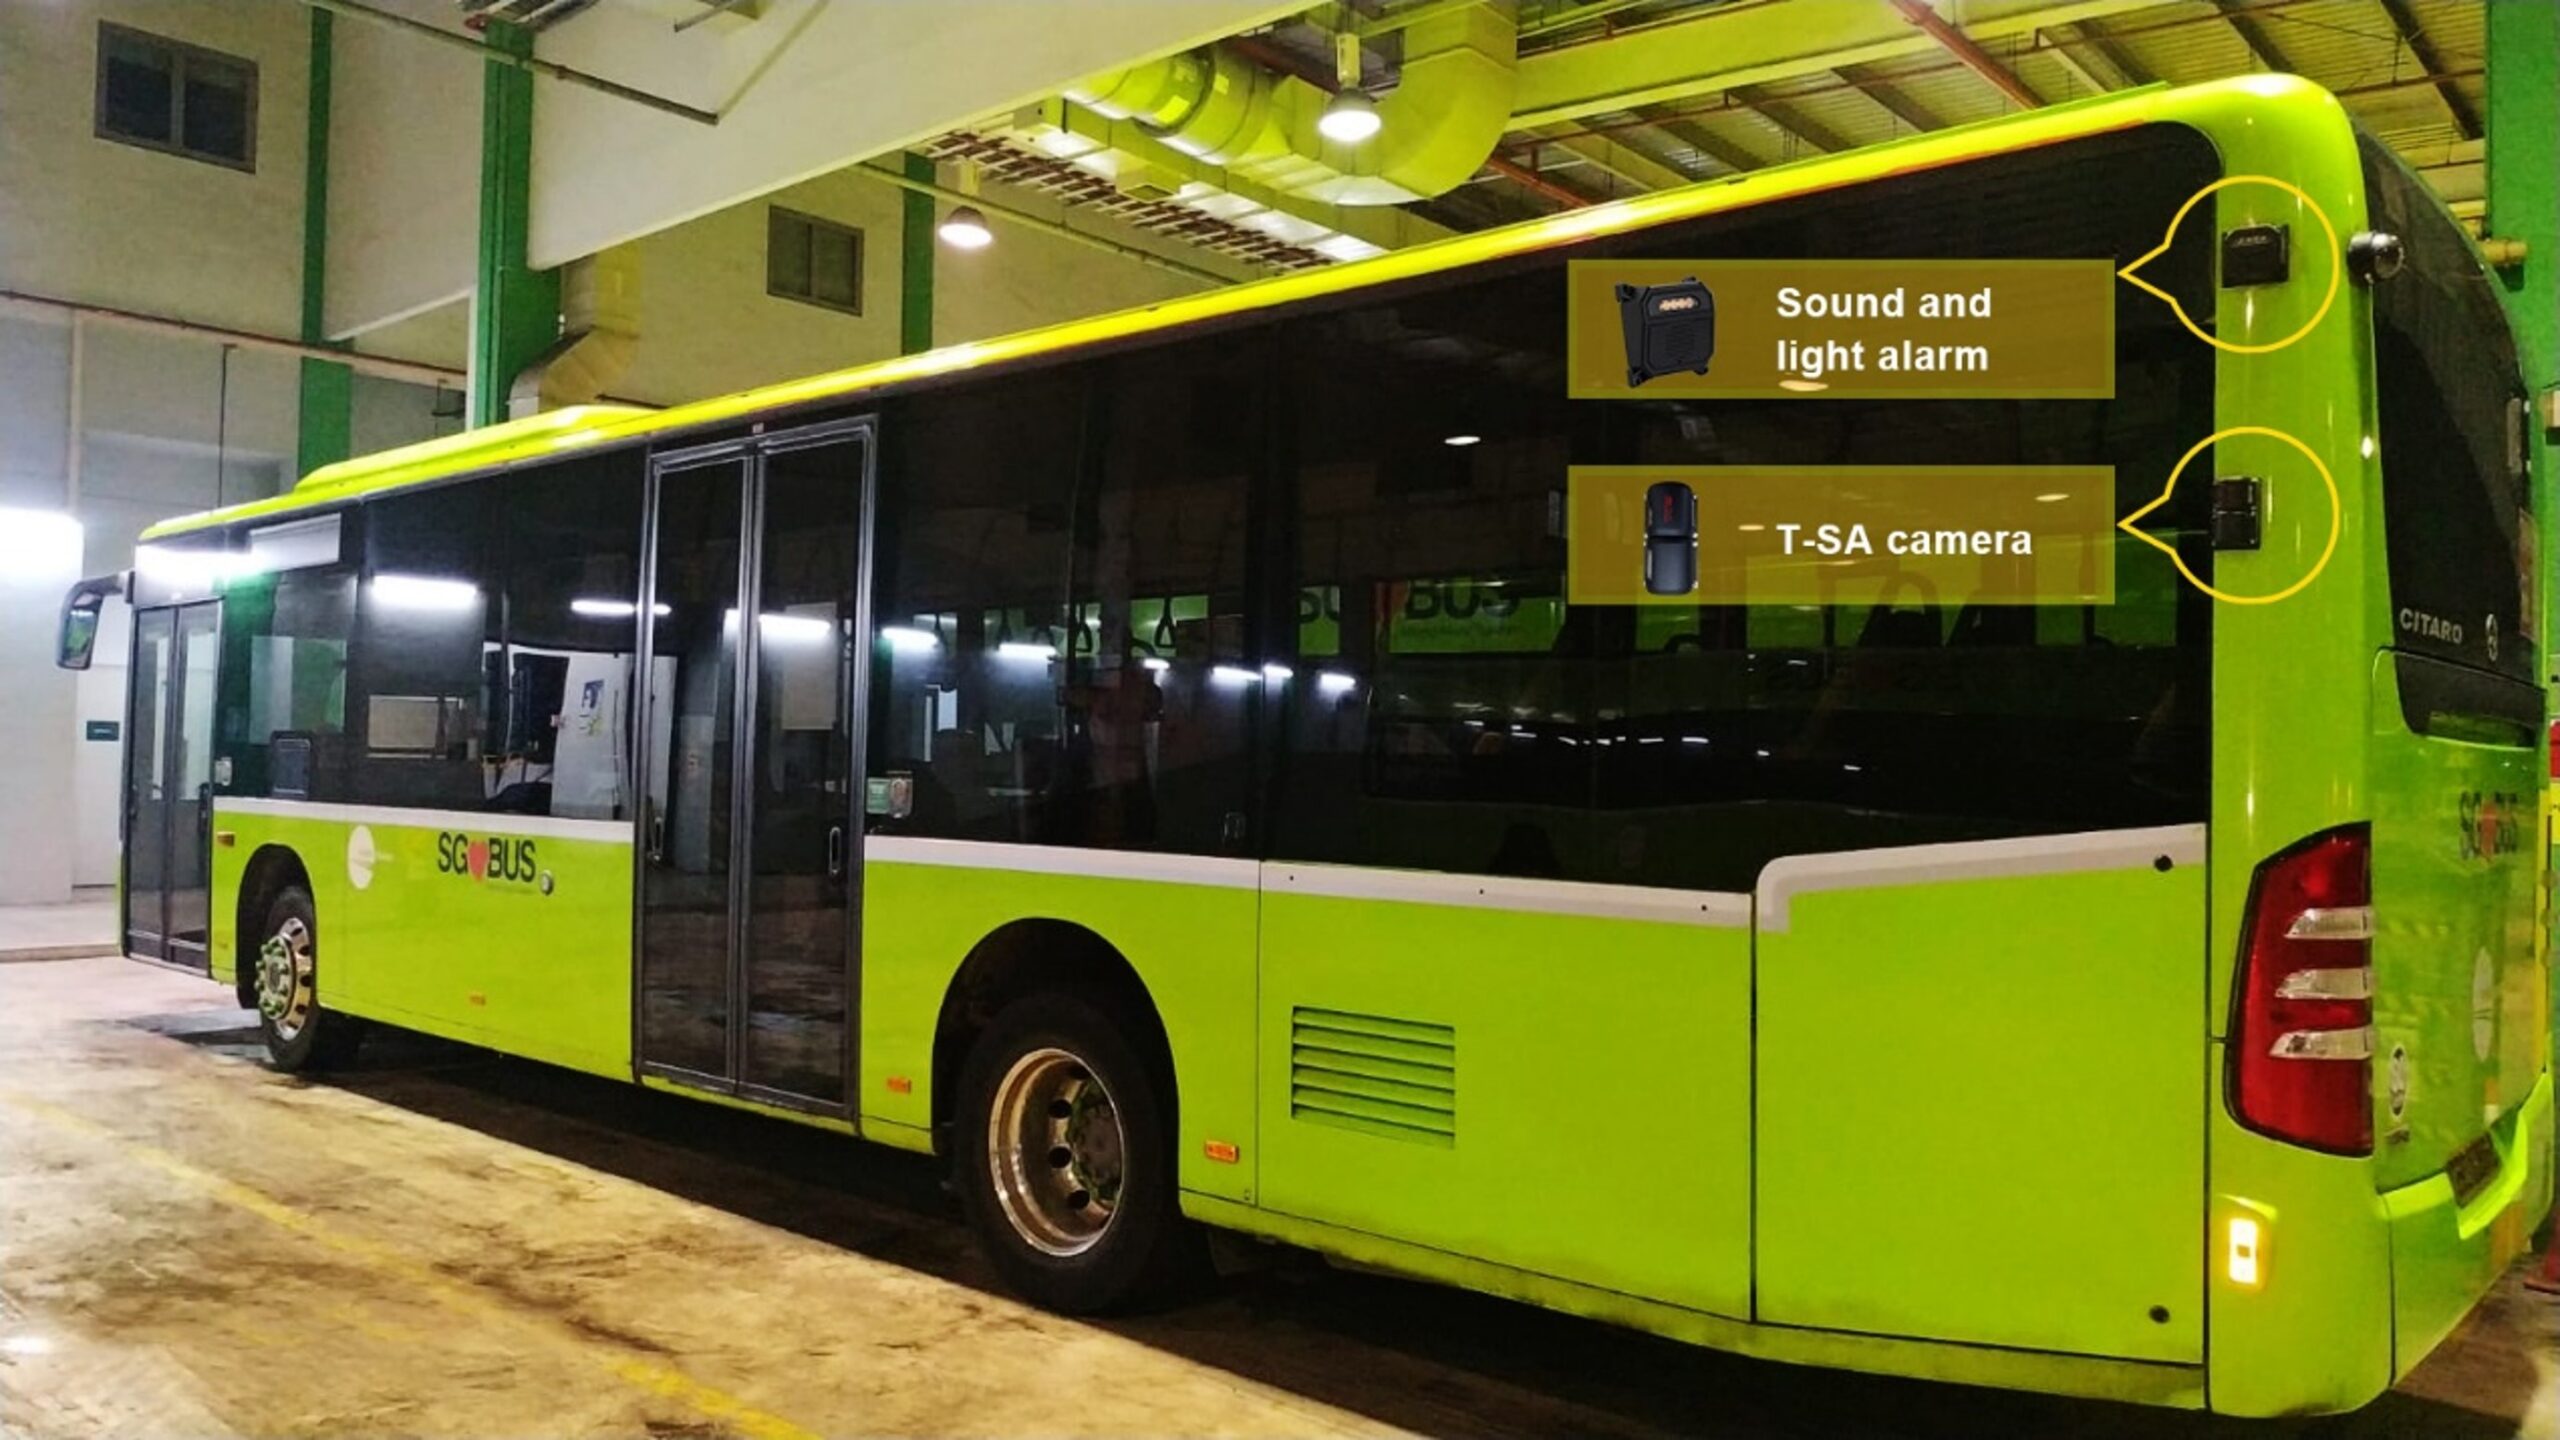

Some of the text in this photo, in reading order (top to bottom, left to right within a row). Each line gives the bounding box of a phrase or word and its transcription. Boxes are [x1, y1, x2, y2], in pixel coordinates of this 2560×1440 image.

[2400, 607, 2463, 645] CITARO
[438, 831, 537, 883] SG BUS
